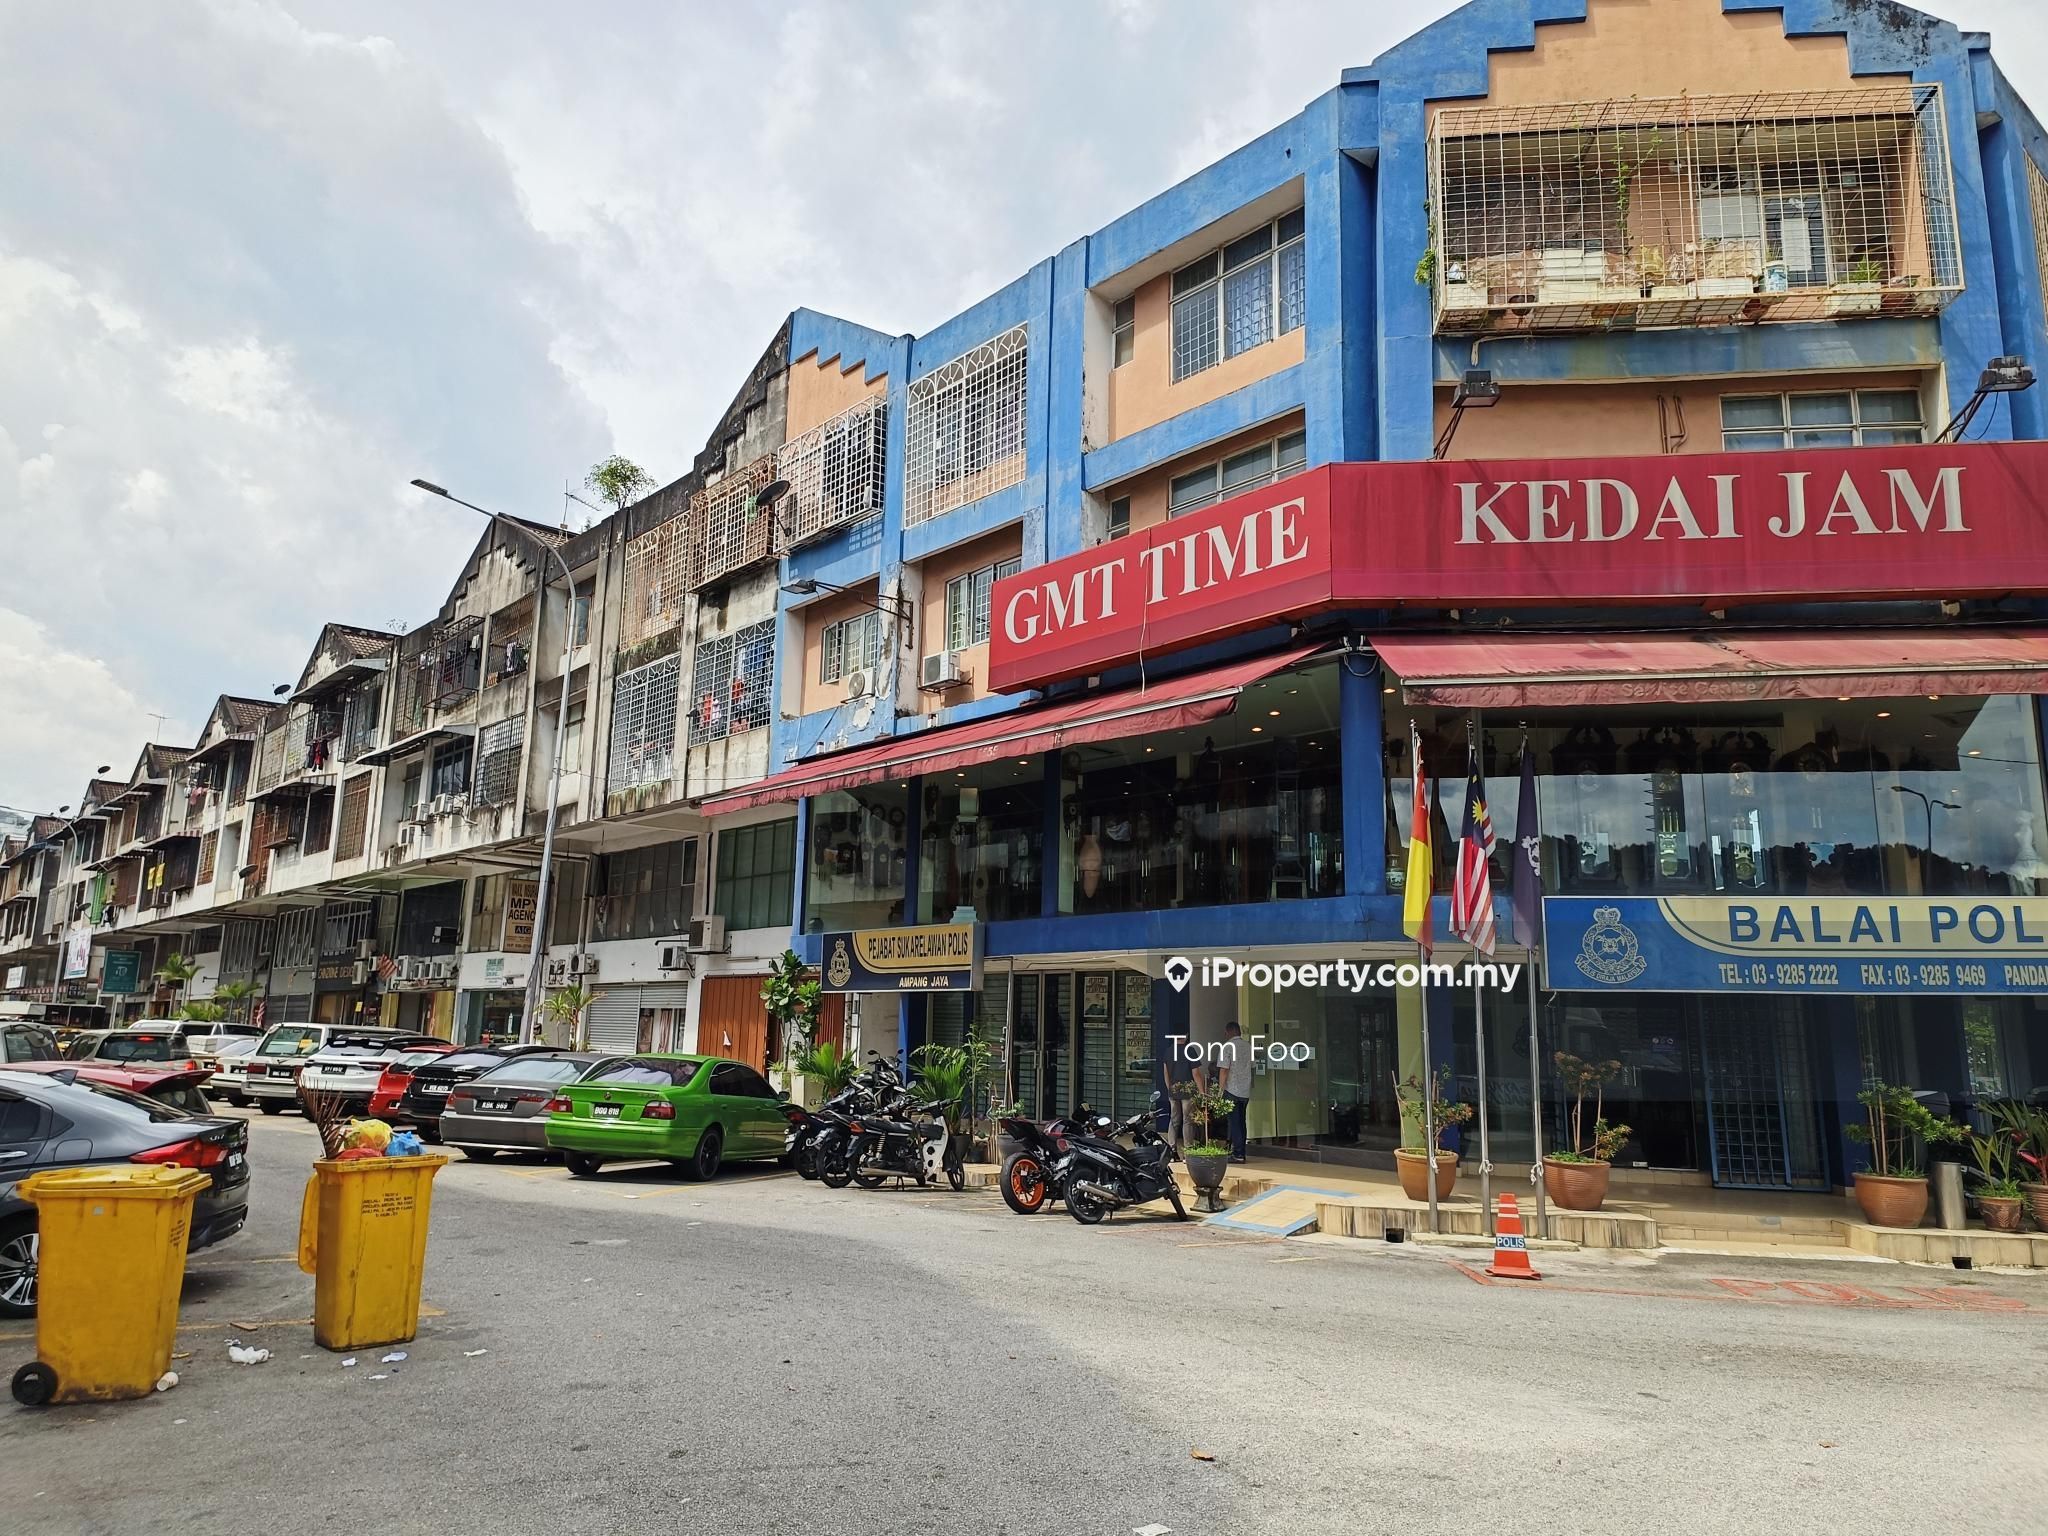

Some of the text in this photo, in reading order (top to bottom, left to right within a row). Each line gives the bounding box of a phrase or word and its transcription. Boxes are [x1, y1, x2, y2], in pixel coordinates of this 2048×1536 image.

[1453, 466, 1972, 544] KEDAI JAM
[1004, 497, 1309, 644] GMT TIME
[508, 909, 536, 921] AGENC
[1727, 904, 2045, 944] BALAI POL
[868, 931, 968, 960] PEJABAT SUKARELAWAN POLIS
[899, 975, 949, 988] AMPANG JAYA
[1616, 967, 1641, 982] MALAYSIA
[1777, 963, 1806, 985] 9285
[1808, 963, 1839, 985] 2222
[1919, 964, 1950, 986] 9285
[1956, 964, 1986, 986] 9469
[1497, 1237, 1525, 1248] POLIS
